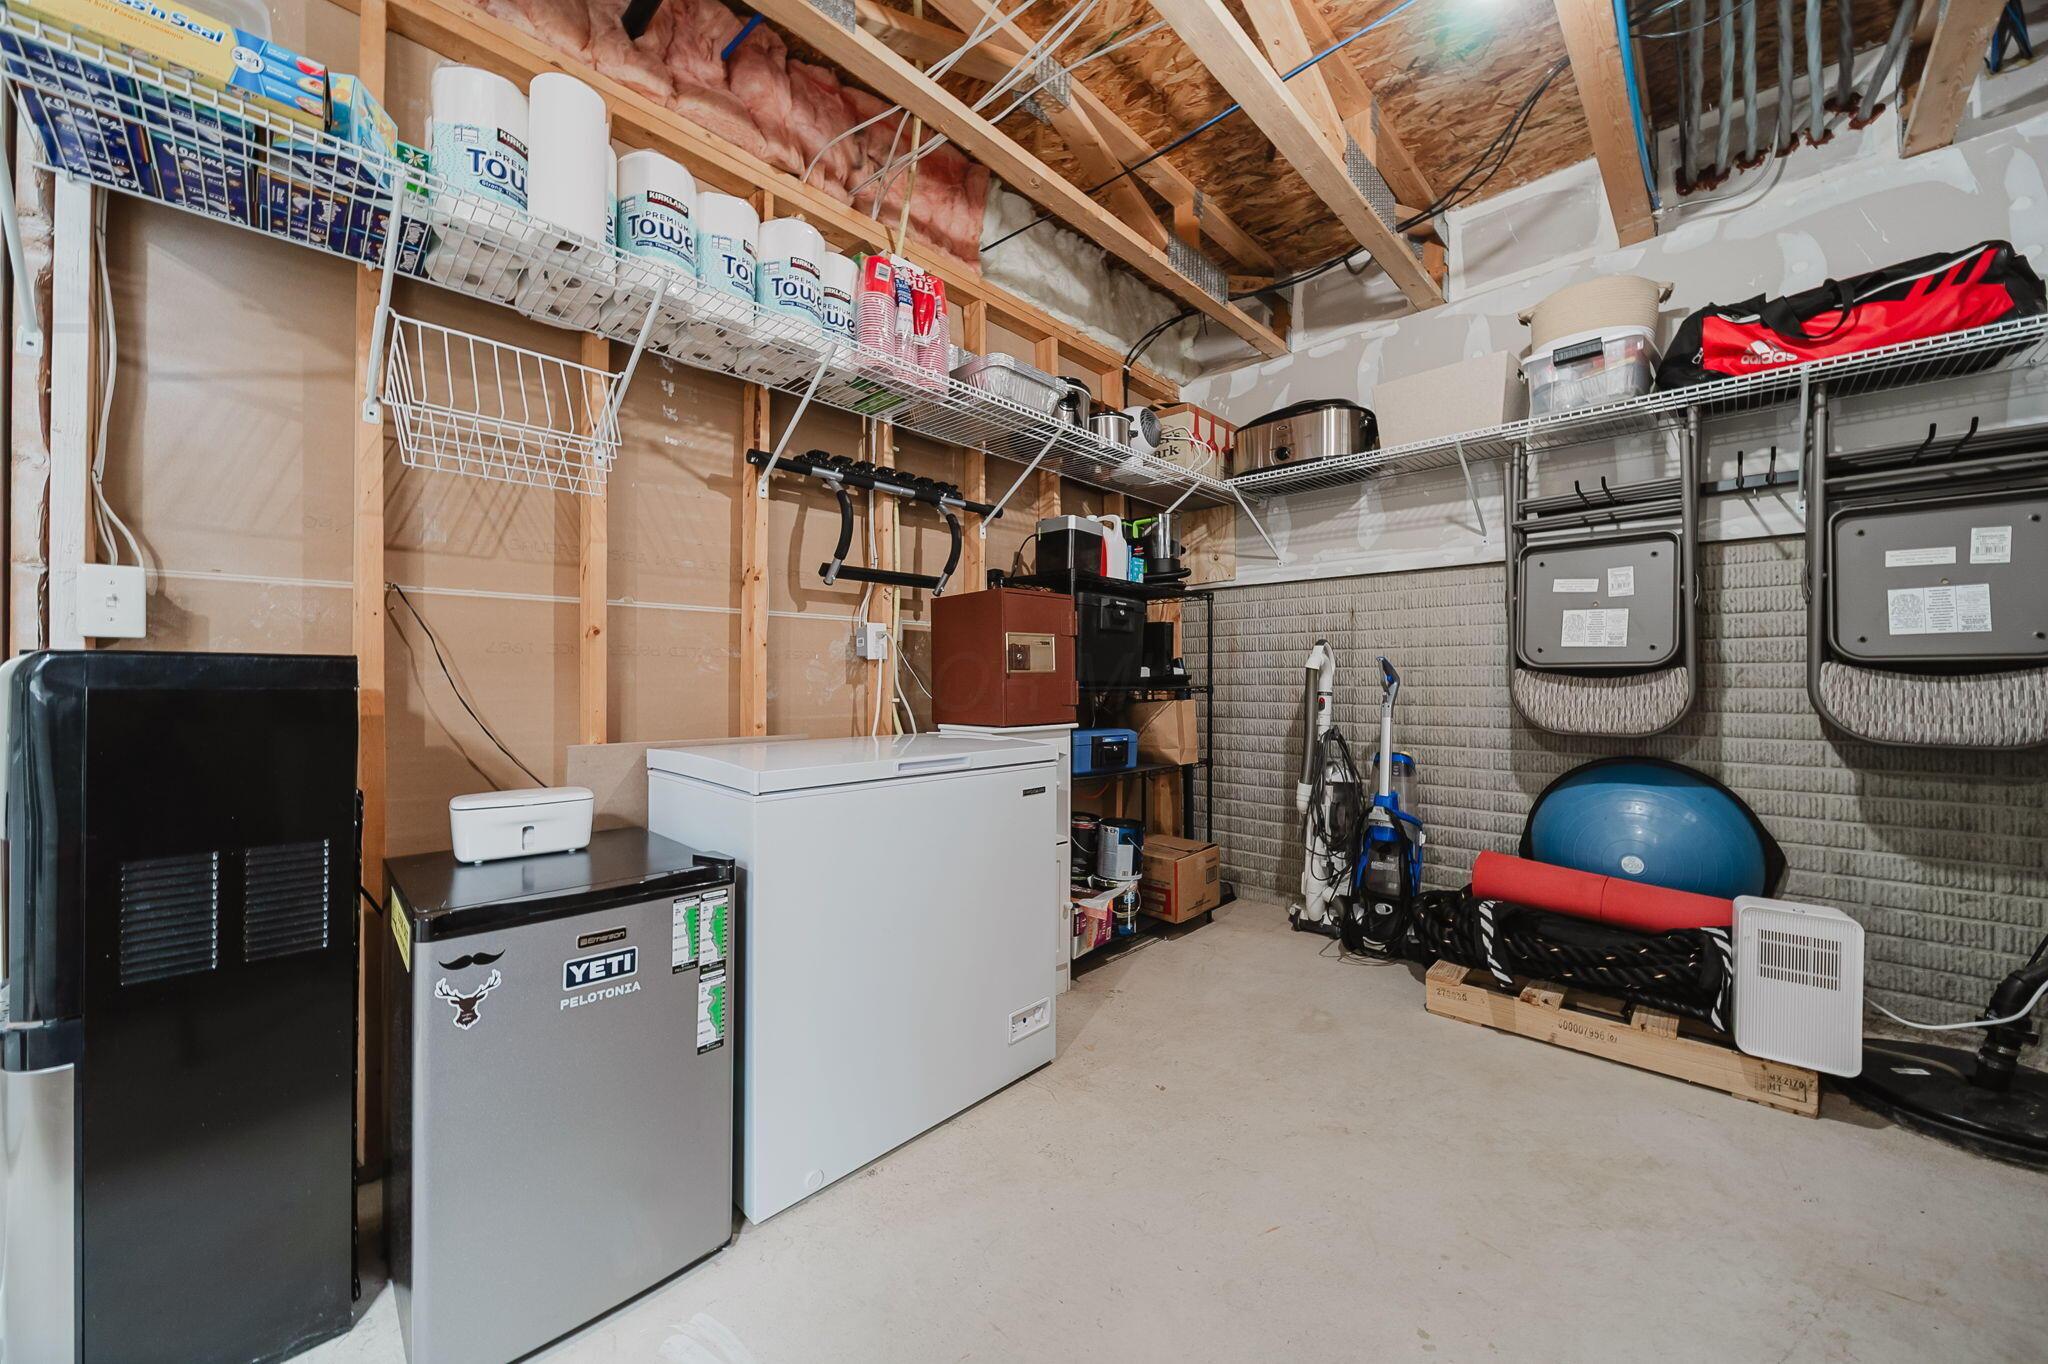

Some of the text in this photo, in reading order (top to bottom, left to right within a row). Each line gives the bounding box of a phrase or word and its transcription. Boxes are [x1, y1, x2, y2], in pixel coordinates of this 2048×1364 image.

[170, 12, 225, 44] Seal
[648, 191, 688, 213] KIRKLAND
[645, 211, 689, 231] PREMIUM
[628, 214, 694, 255] Towe
[1741, 350, 1798, 365] adidas
[1153, 445, 1180, 459] ark
[569, 953, 632, 983] YETI
[560, 981, 641, 1010] PELOTONIA
